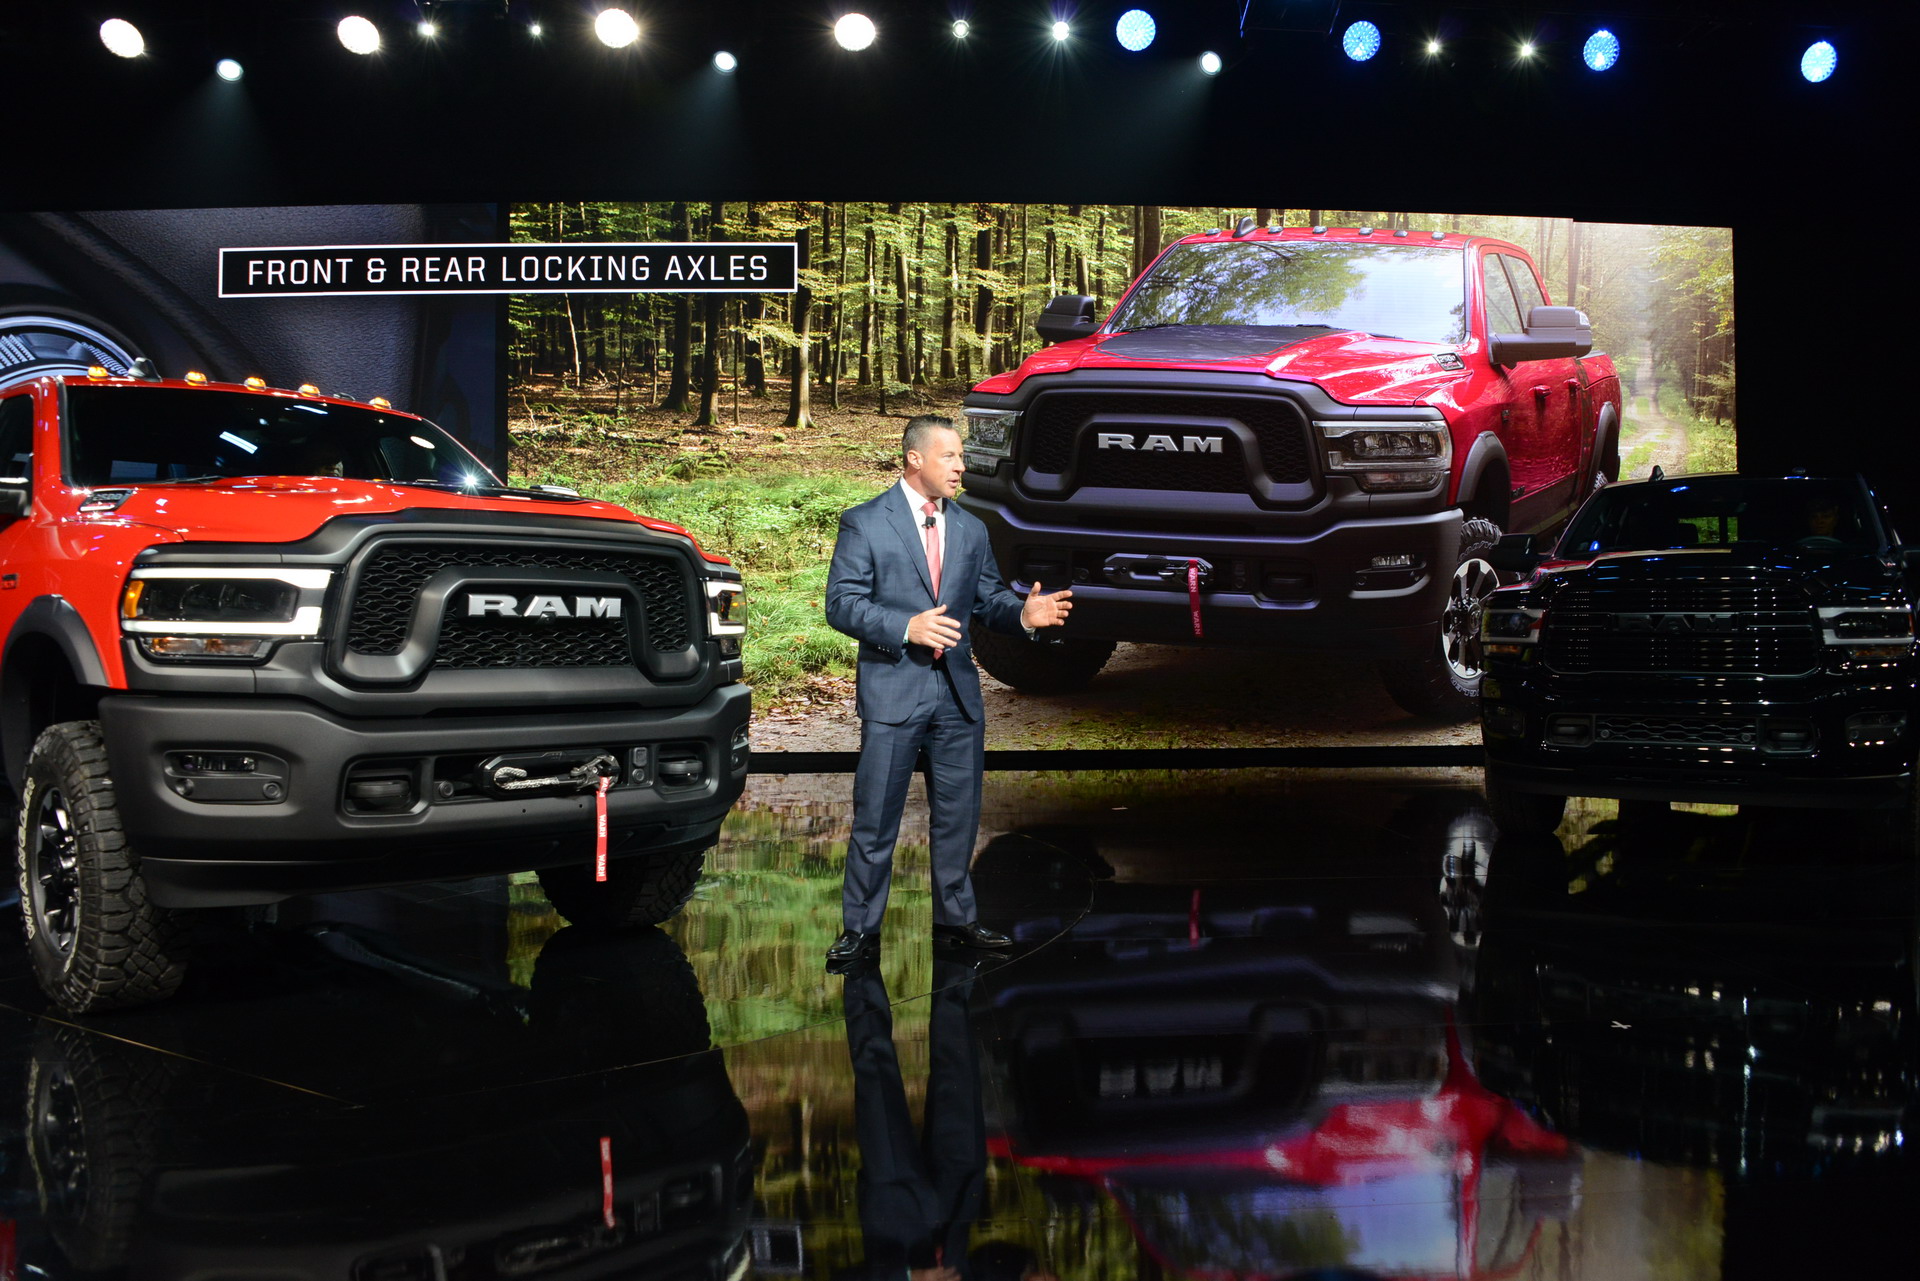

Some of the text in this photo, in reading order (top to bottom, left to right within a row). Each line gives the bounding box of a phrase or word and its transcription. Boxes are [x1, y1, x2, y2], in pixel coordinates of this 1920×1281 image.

[248, 254, 768, 286] FRONT & REAR LOCKING AXLES
[1098, 432, 1223, 453] RAM
[468, 593, 622, 618] RAM
[599, 814, 607, 838] WARN
[598, 854, 606, 877] WARN
